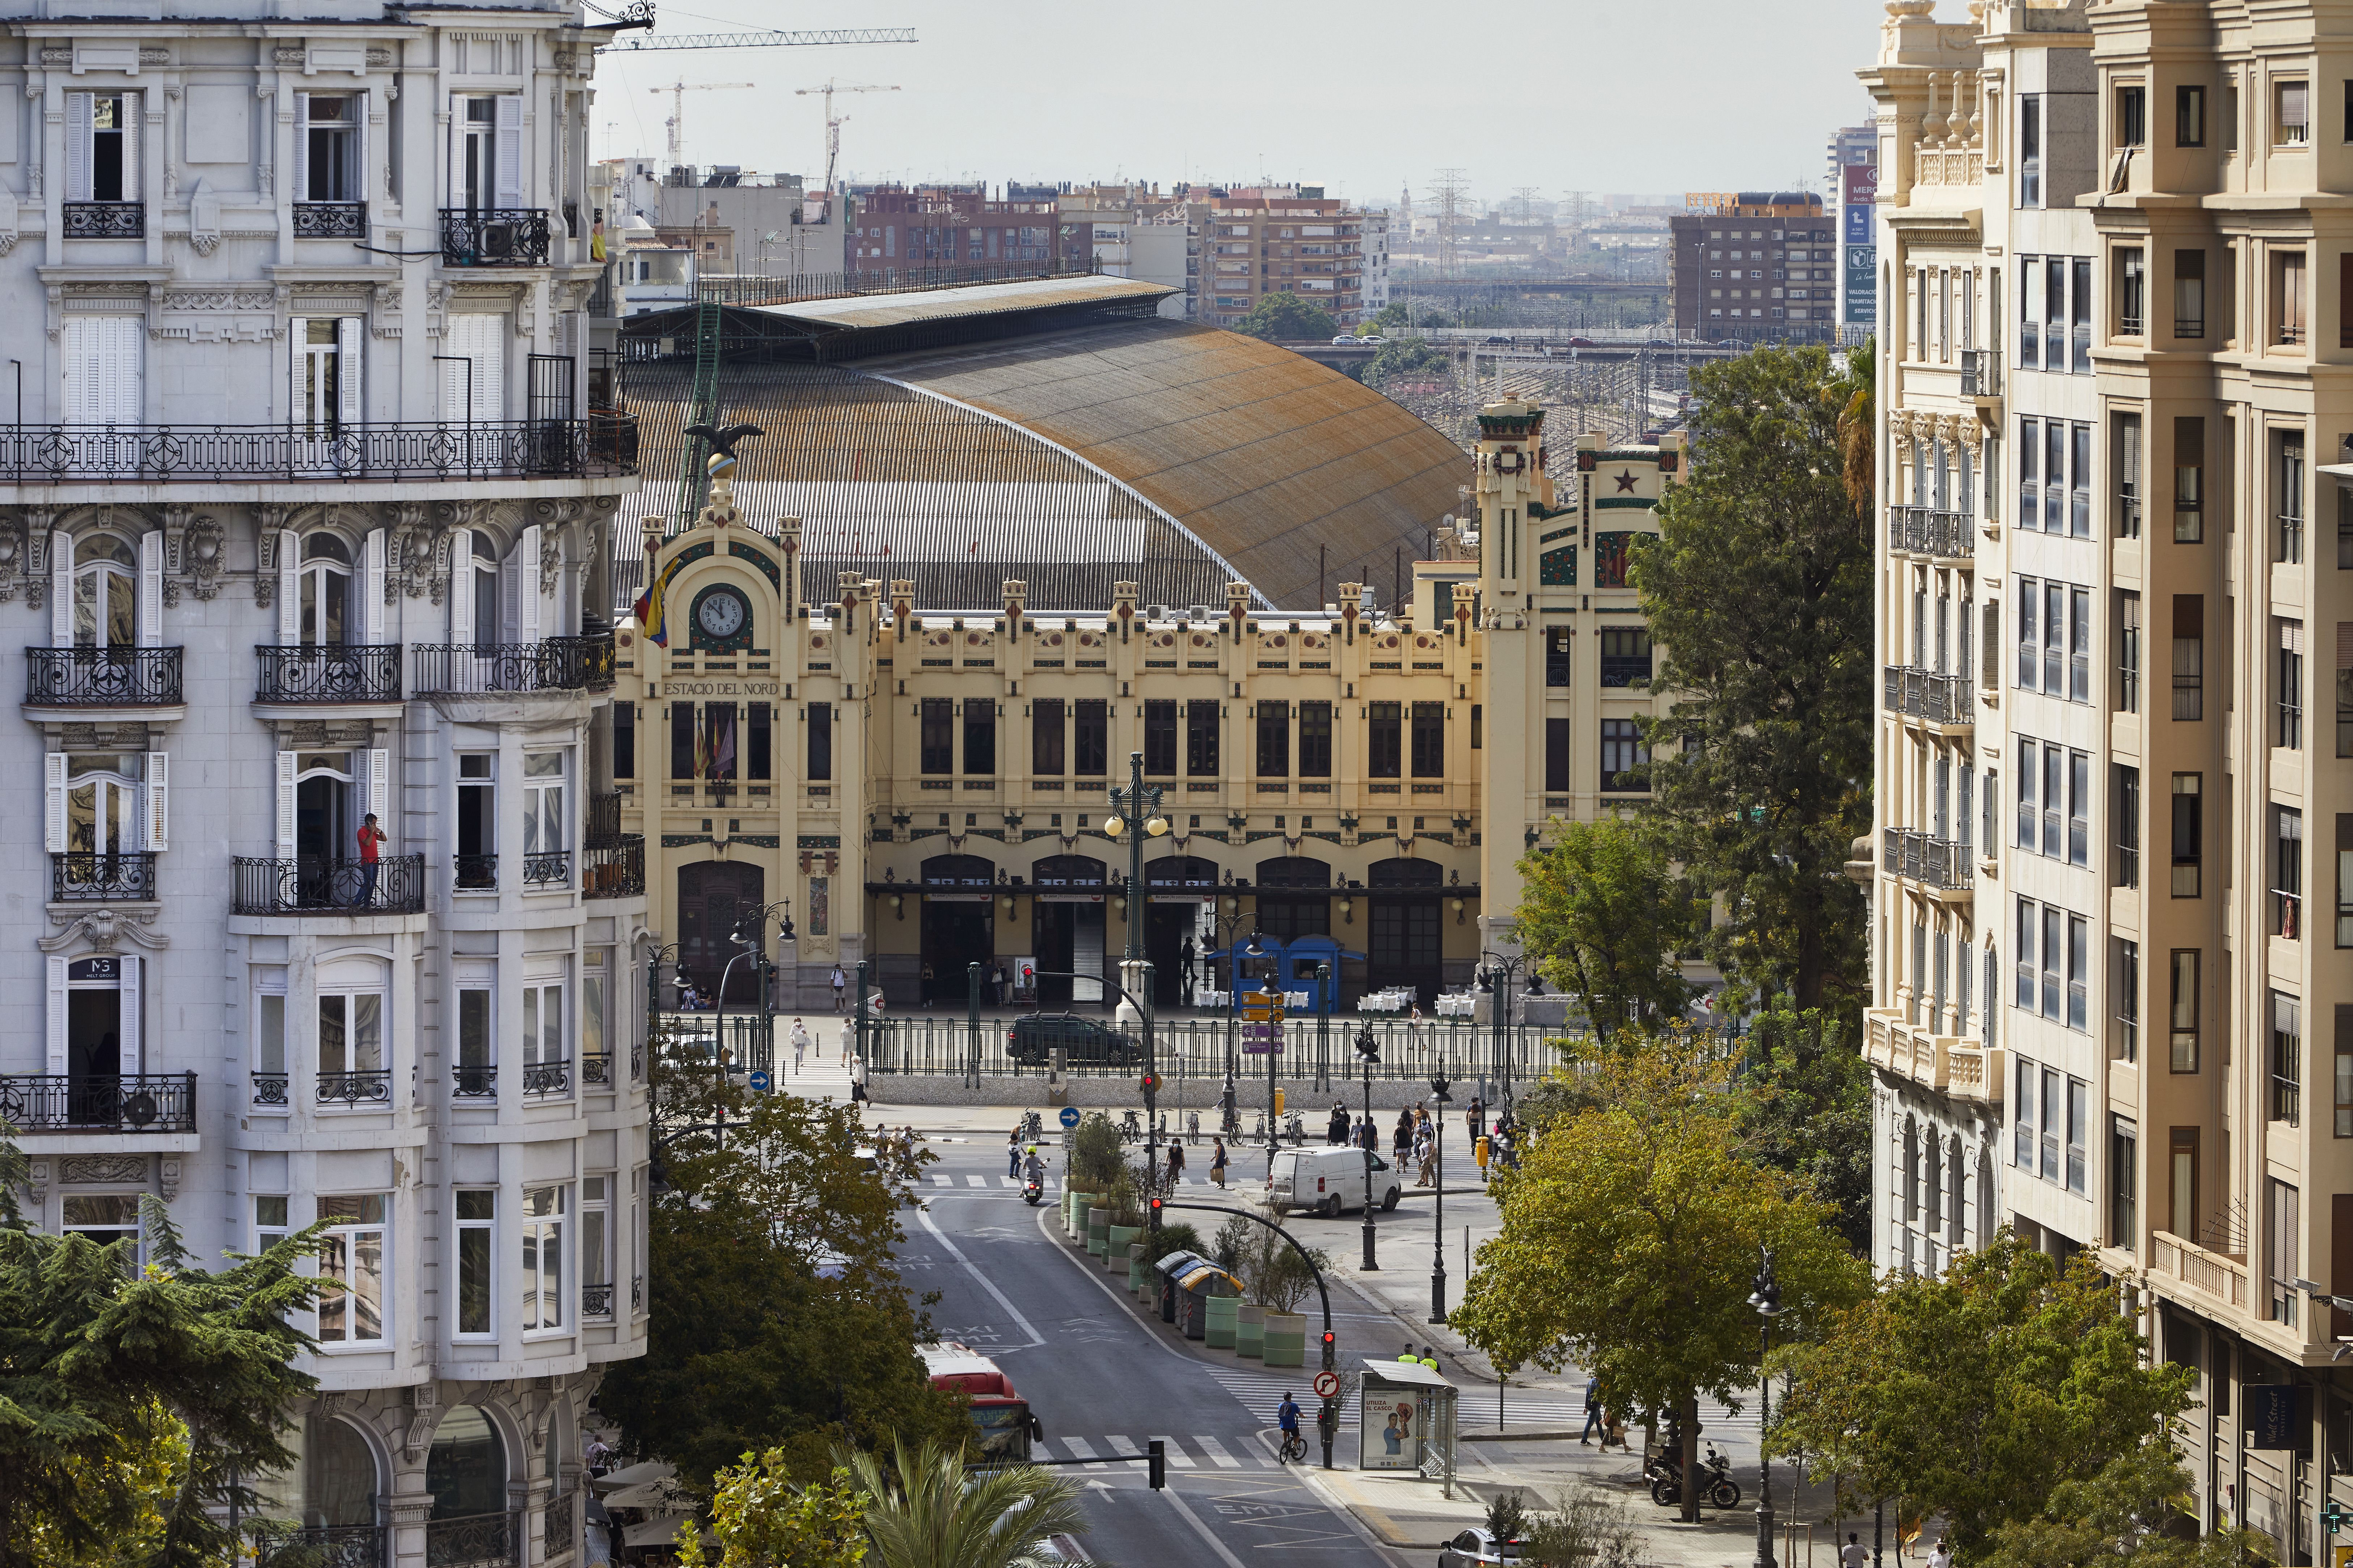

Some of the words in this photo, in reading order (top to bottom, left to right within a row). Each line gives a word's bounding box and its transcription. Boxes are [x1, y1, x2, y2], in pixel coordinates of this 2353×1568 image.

[1685, 192, 1740, 207] ITURBI
[664, 680, 714, 695] ESTACIÓ
[717, 683, 742, 695] DEL
[744, 683, 778, 695] NORD
[92, 960, 109, 972] MG
[937, 1326, 993, 1334] AXI
[2268, 1391, 2278, 1422] Street
[2266, 1424, 2277, 1442] Wall
[1213, 1505, 1289, 1515] EMT
